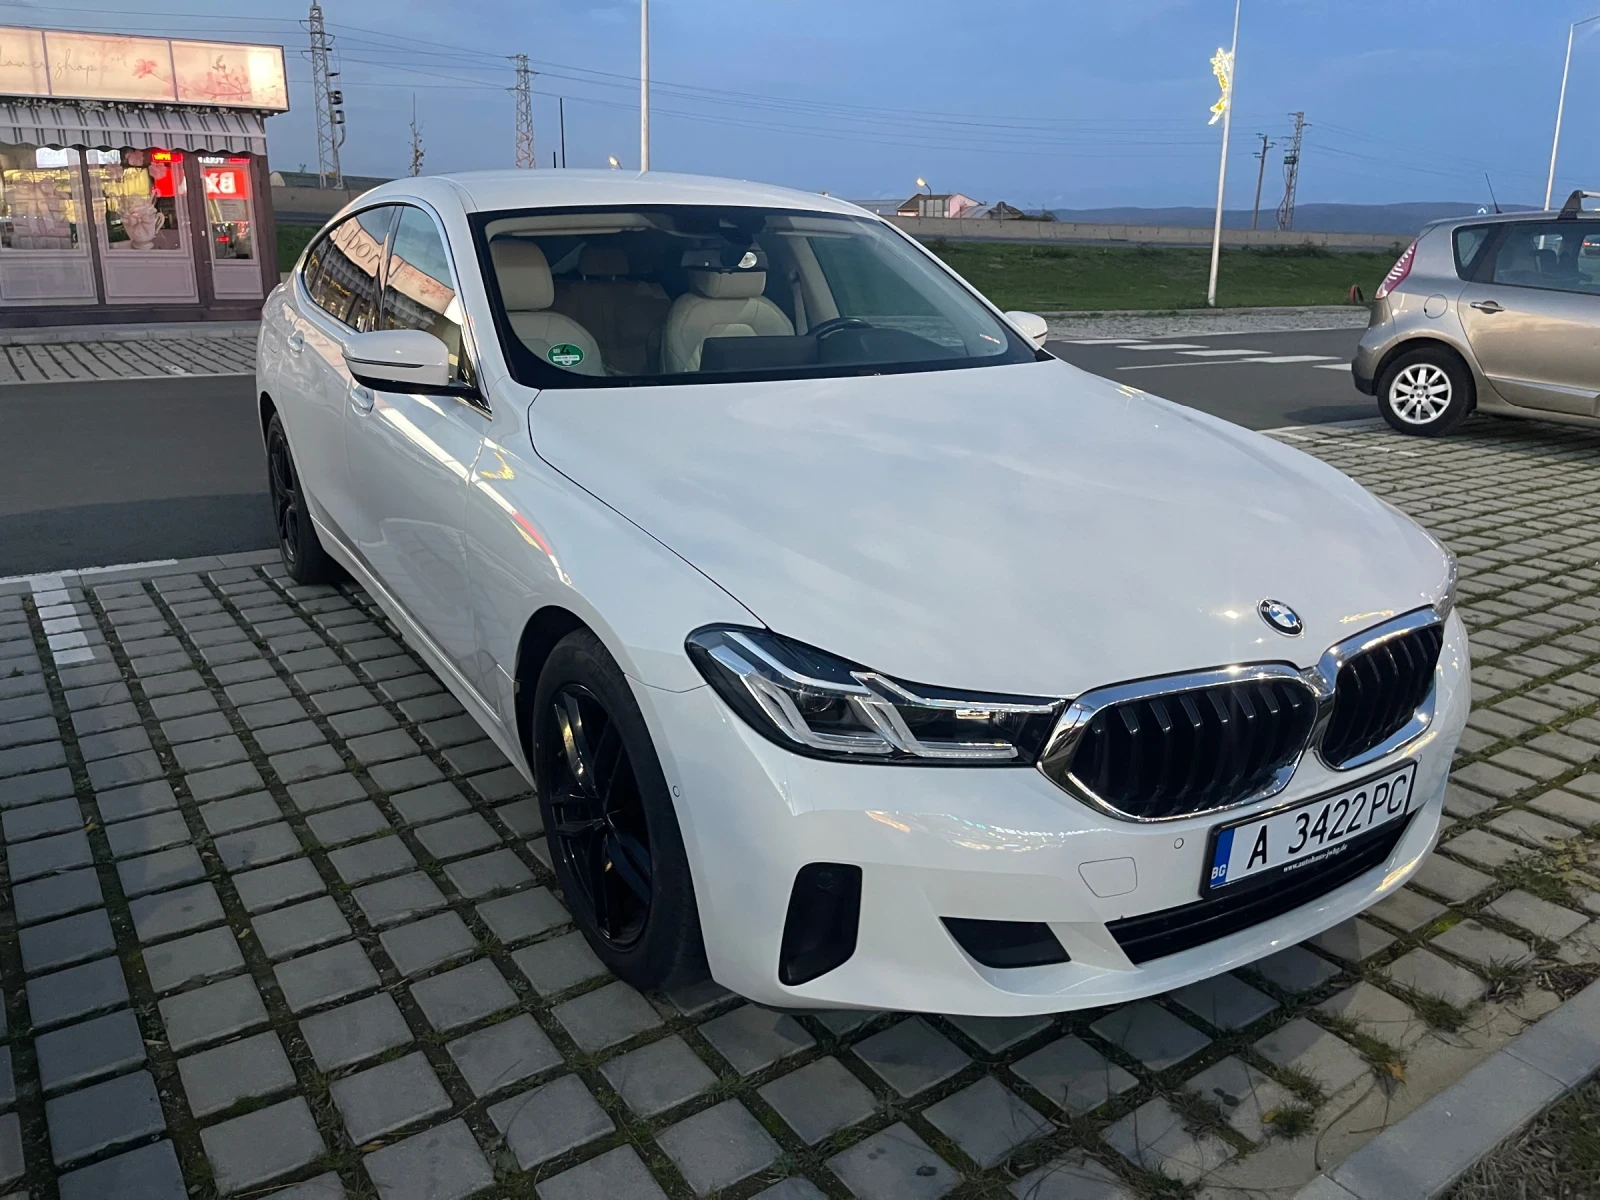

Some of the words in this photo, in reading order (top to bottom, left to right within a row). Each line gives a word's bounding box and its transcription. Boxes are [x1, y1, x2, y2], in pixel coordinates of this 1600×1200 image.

[54, 48, 97, 84] shop
[560, 344, 571, 356] 4
[1246, 825, 1268, 870] A
[1211, 864, 1227, 880] BG
